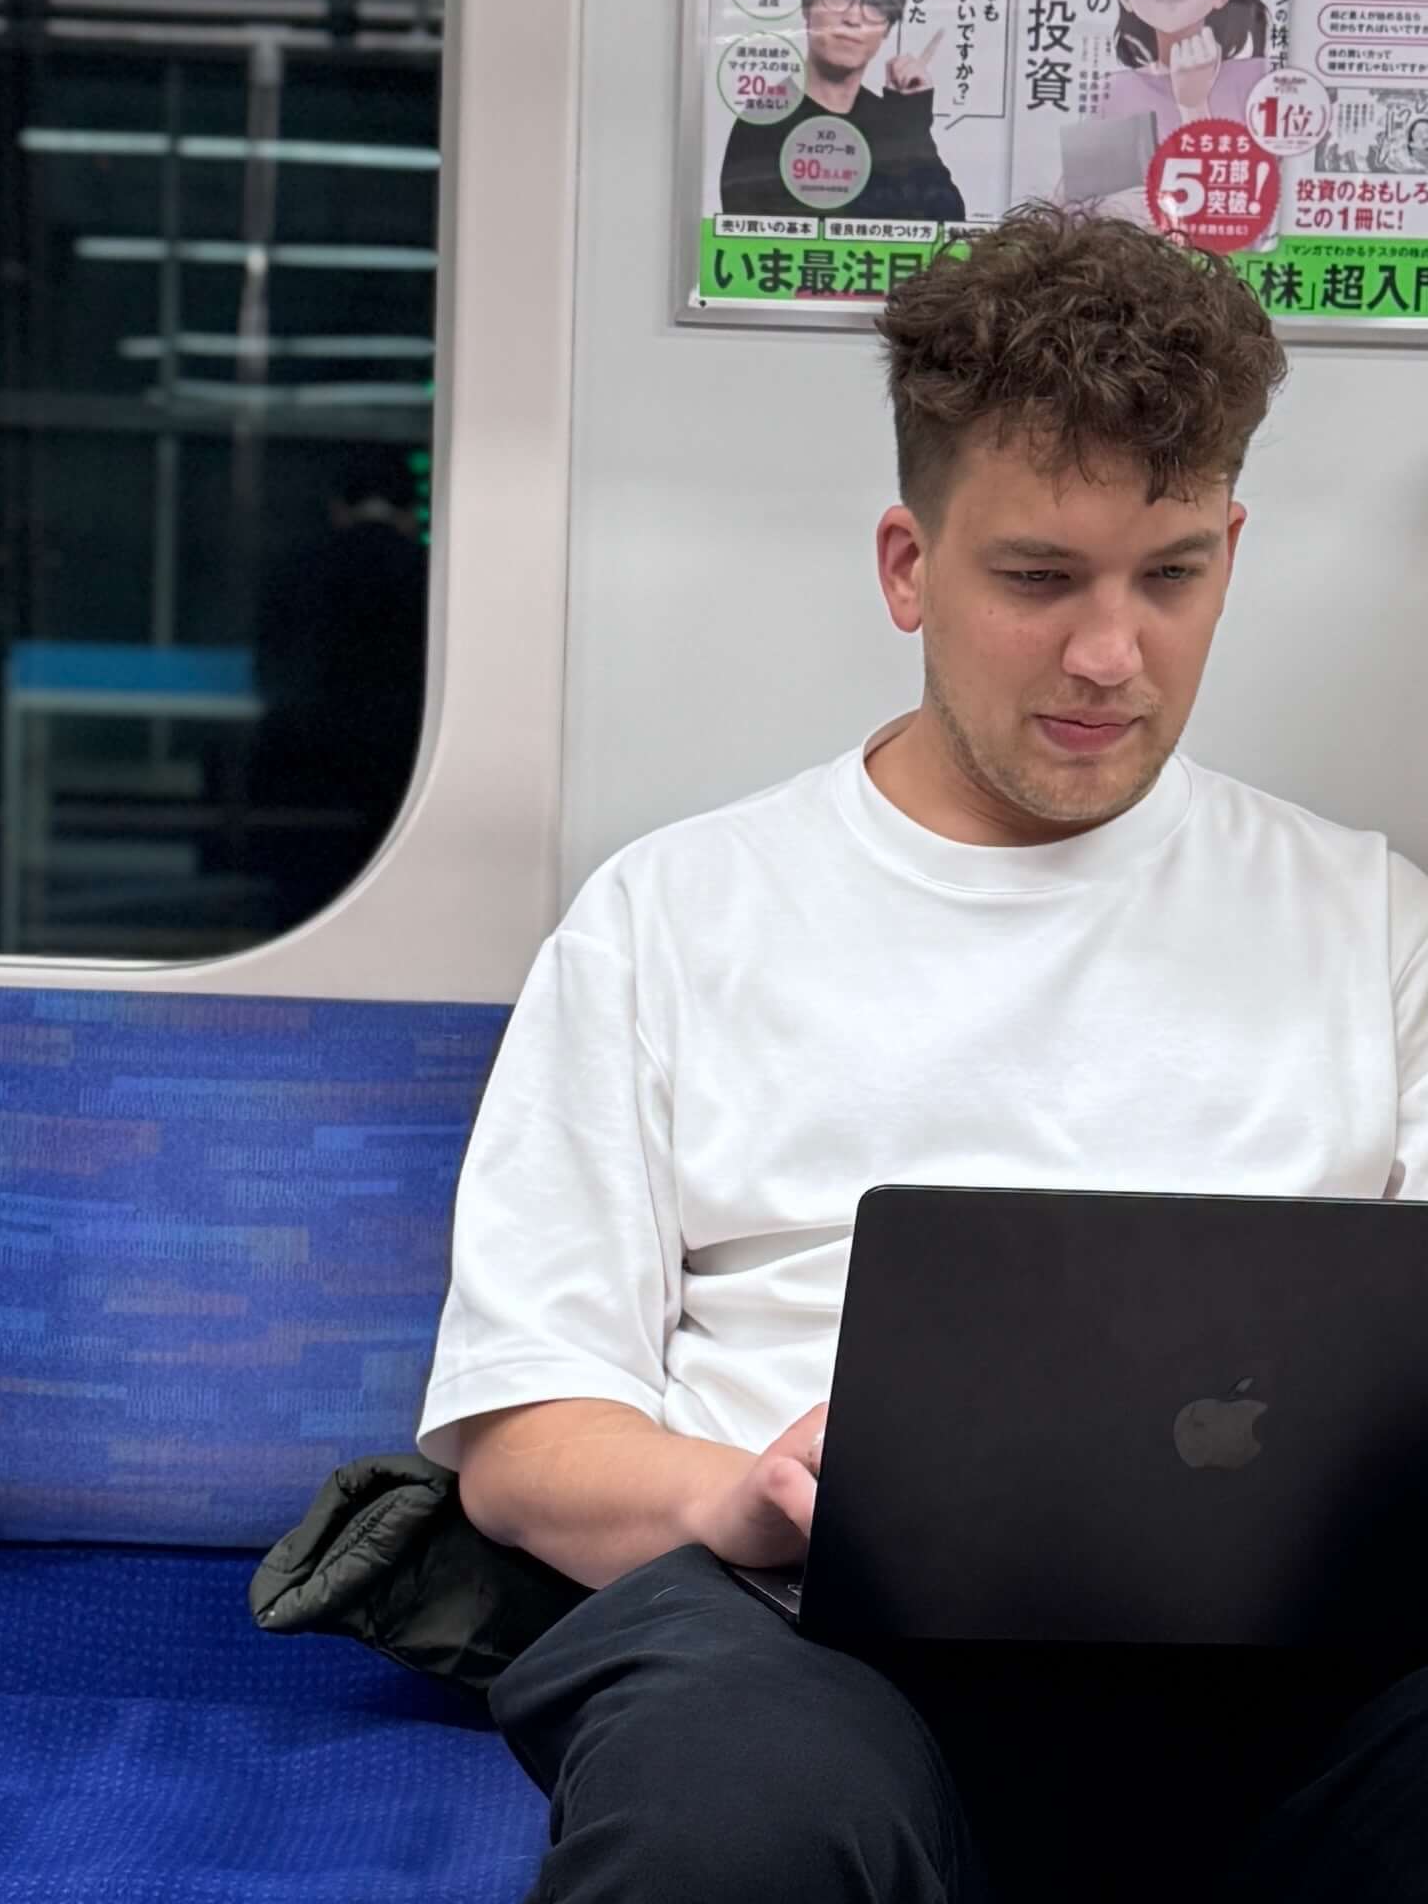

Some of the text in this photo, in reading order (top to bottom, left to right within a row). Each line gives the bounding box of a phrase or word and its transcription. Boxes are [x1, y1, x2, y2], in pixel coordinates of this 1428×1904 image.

[1179, 133, 1252, 154] たちまち
[1157, 156, 1206, 218] 5
[721, 219, 813, 236] 売り買いの基本
[1294, 206, 1404, 231] この1冊に!
[829, 222, 933, 239] 優良株の見つけ方
